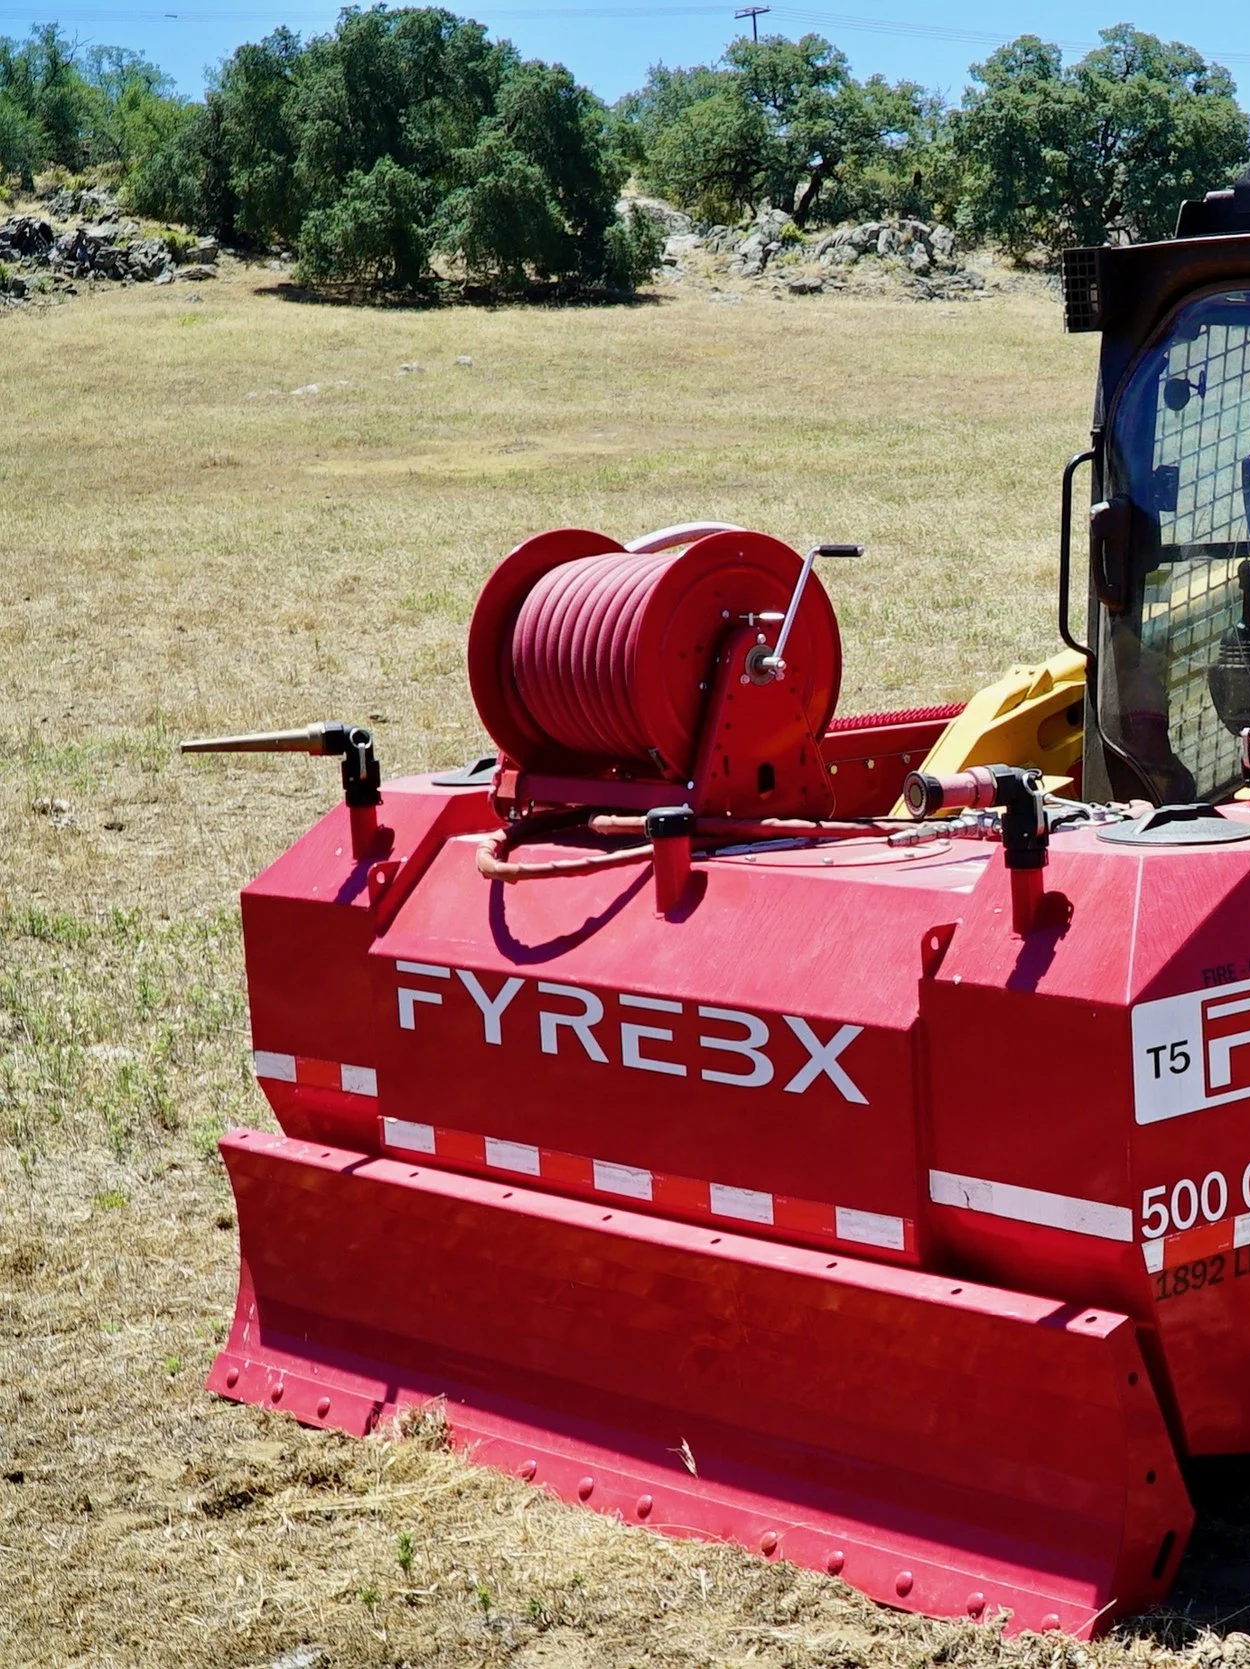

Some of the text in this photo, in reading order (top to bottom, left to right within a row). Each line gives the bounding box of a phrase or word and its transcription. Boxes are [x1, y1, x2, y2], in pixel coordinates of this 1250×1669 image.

[1202, 962, 1237, 986] FIRE
[395, 960, 871, 1105] FYREBX
[1145, 1040, 1192, 1079] T5
[1140, 1170, 1229, 1239] 500
[1155, 1254, 1226, 1302] 1892
